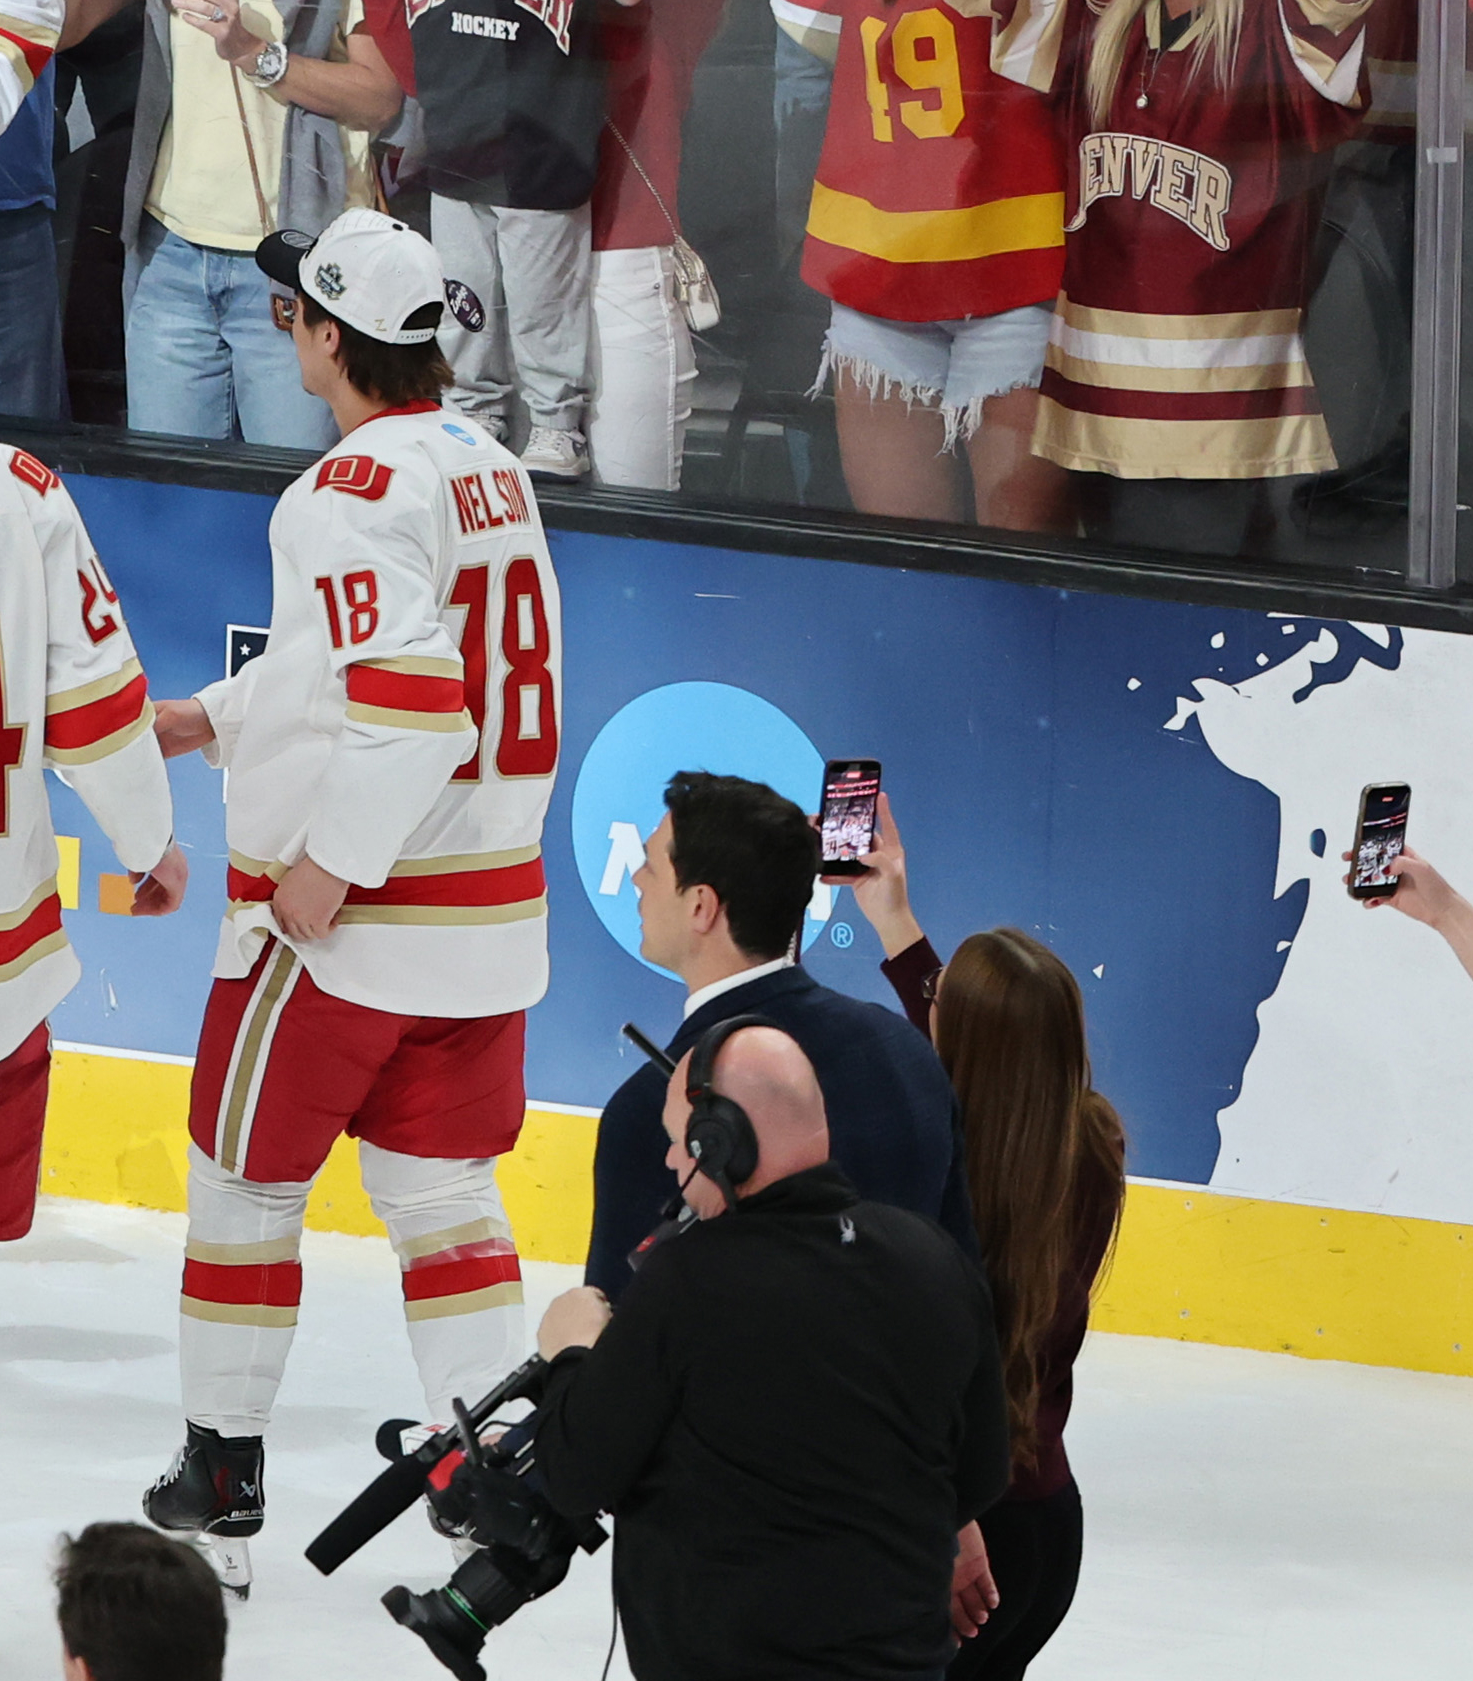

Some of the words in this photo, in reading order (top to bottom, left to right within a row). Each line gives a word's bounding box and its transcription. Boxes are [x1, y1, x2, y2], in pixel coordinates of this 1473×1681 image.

[451, 11, 519, 41] HOCKEY
[859, 8, 966, 143] 19
[1062, 132, 1232, 252] ENVER
[448, 466, 531, 538] NELSON
[315, 569, 381, 651] 18
[445, 554, 558, 786] 18
